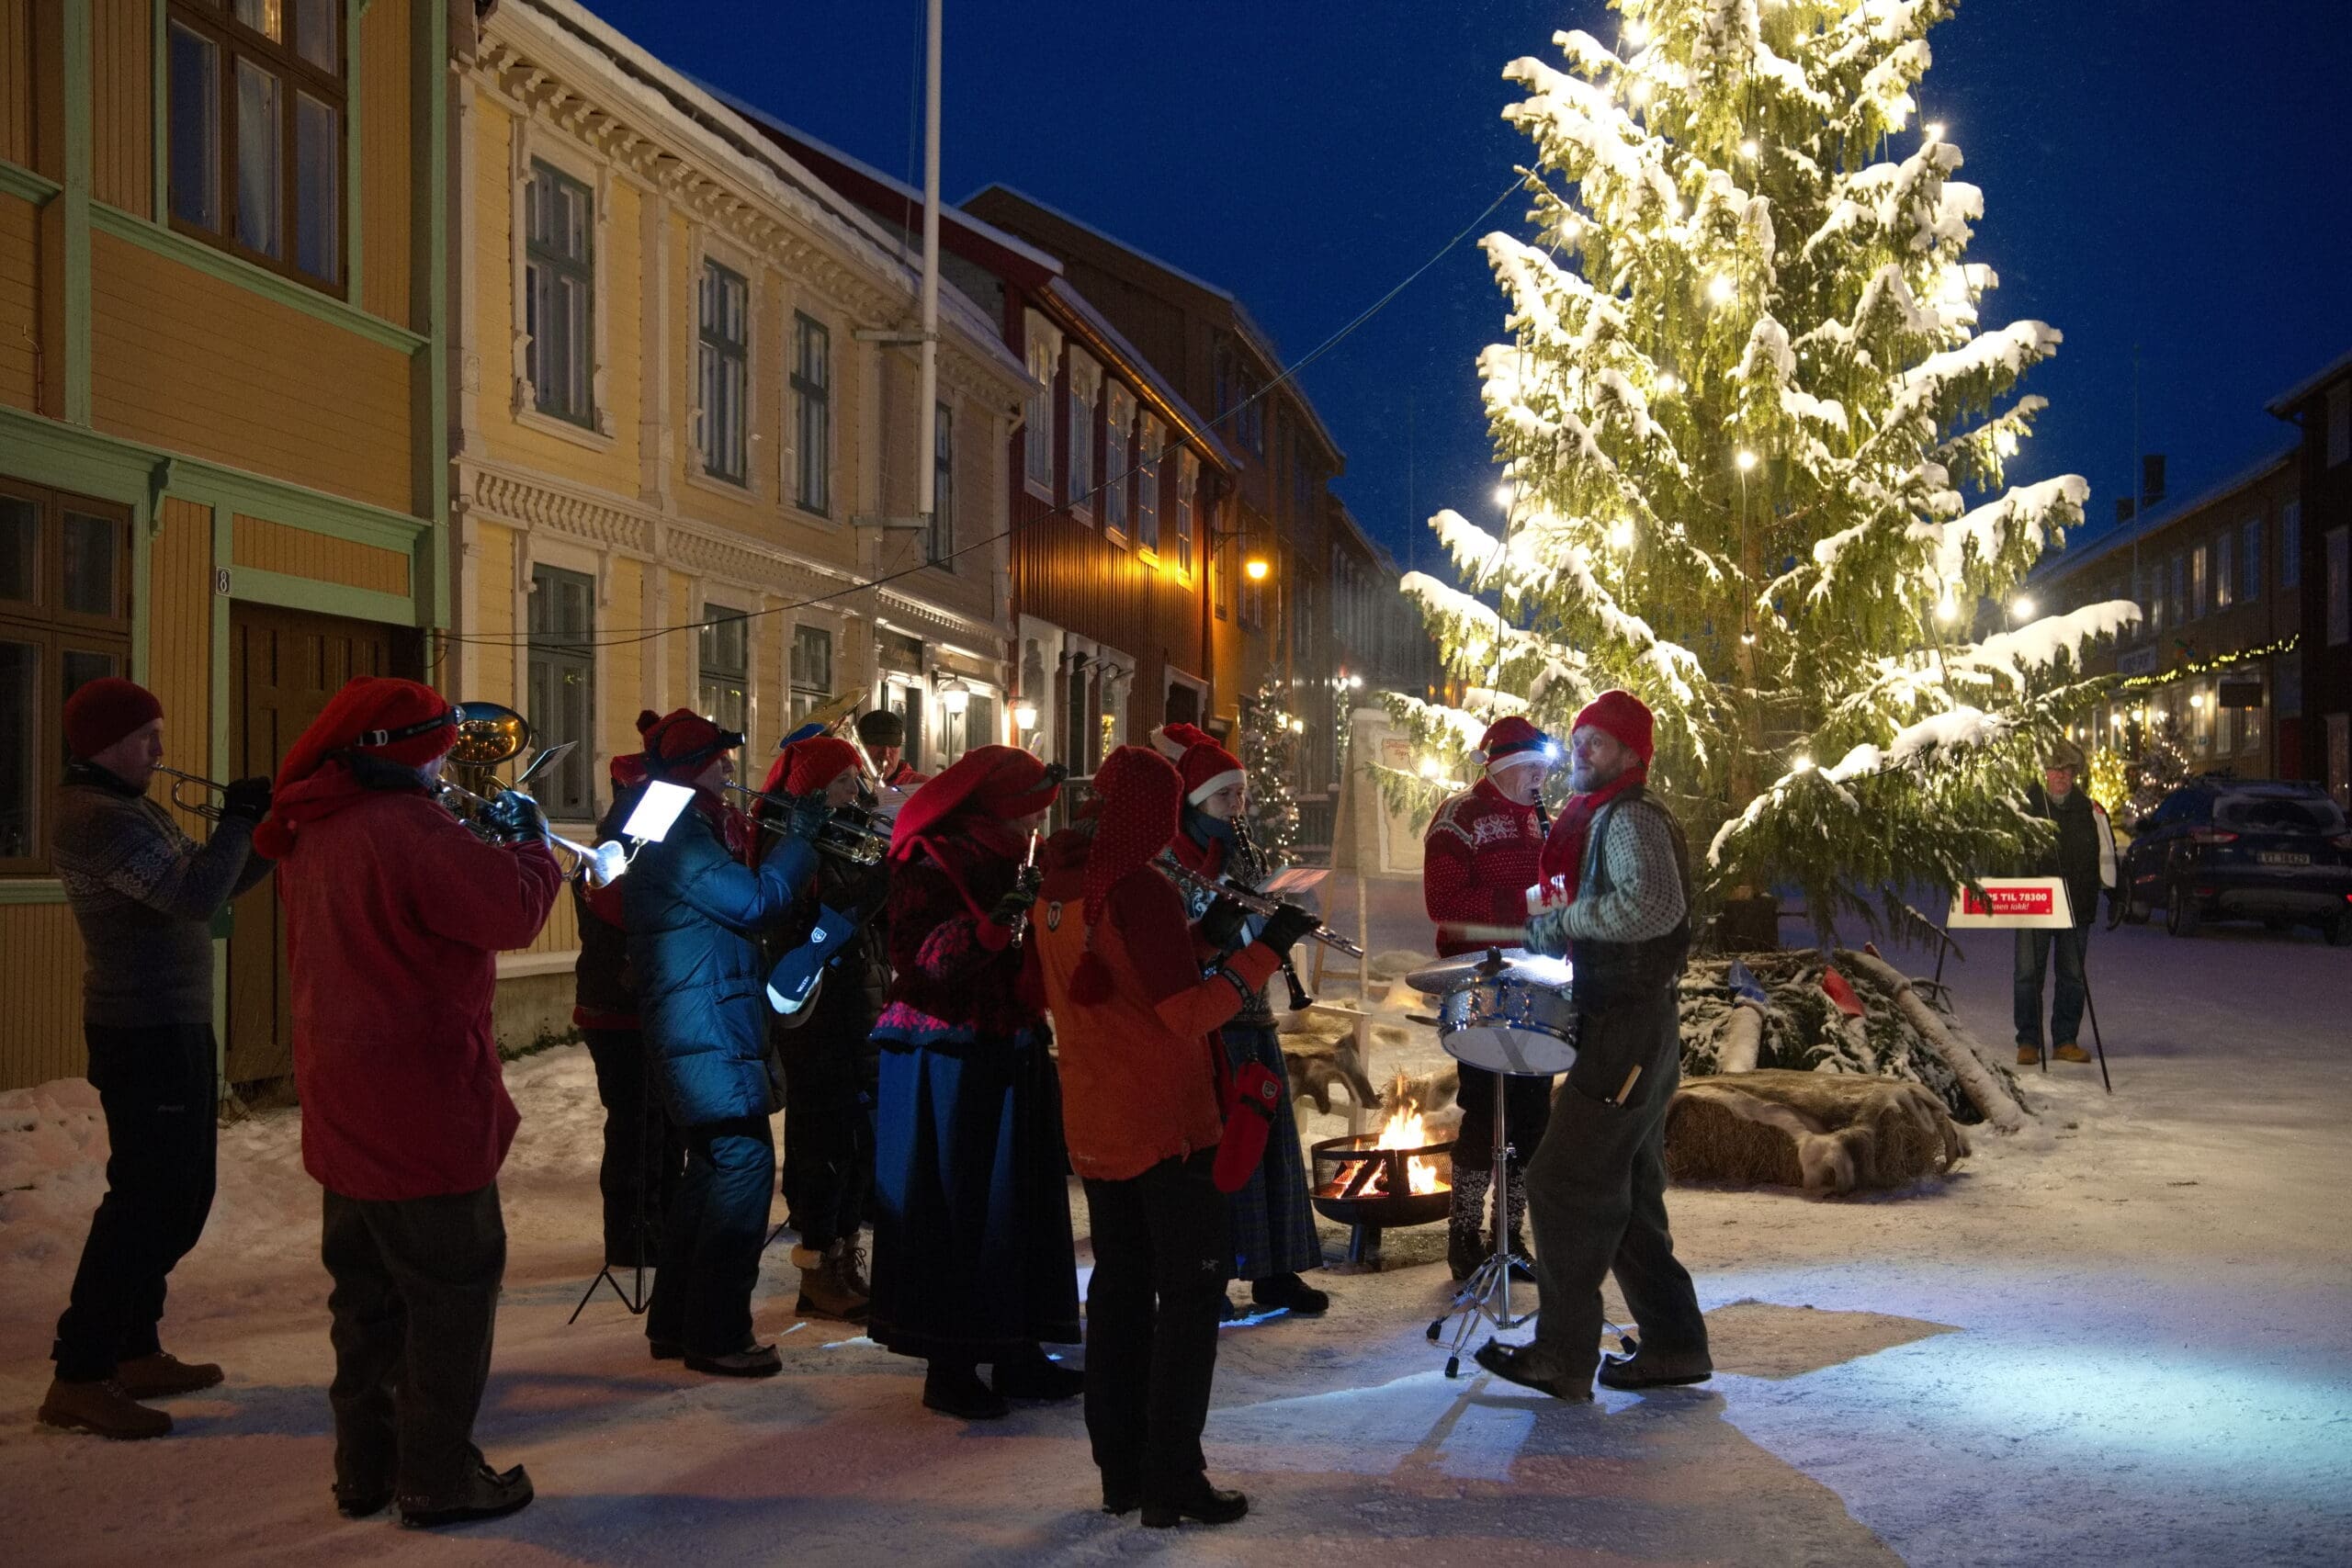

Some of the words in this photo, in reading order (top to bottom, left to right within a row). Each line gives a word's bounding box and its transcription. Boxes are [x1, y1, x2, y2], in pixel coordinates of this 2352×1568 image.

[220, 570, 228, 592] 8
[1999, 893, 2017, 901] TIL
[2018, 893, 2047, 901] 78300
